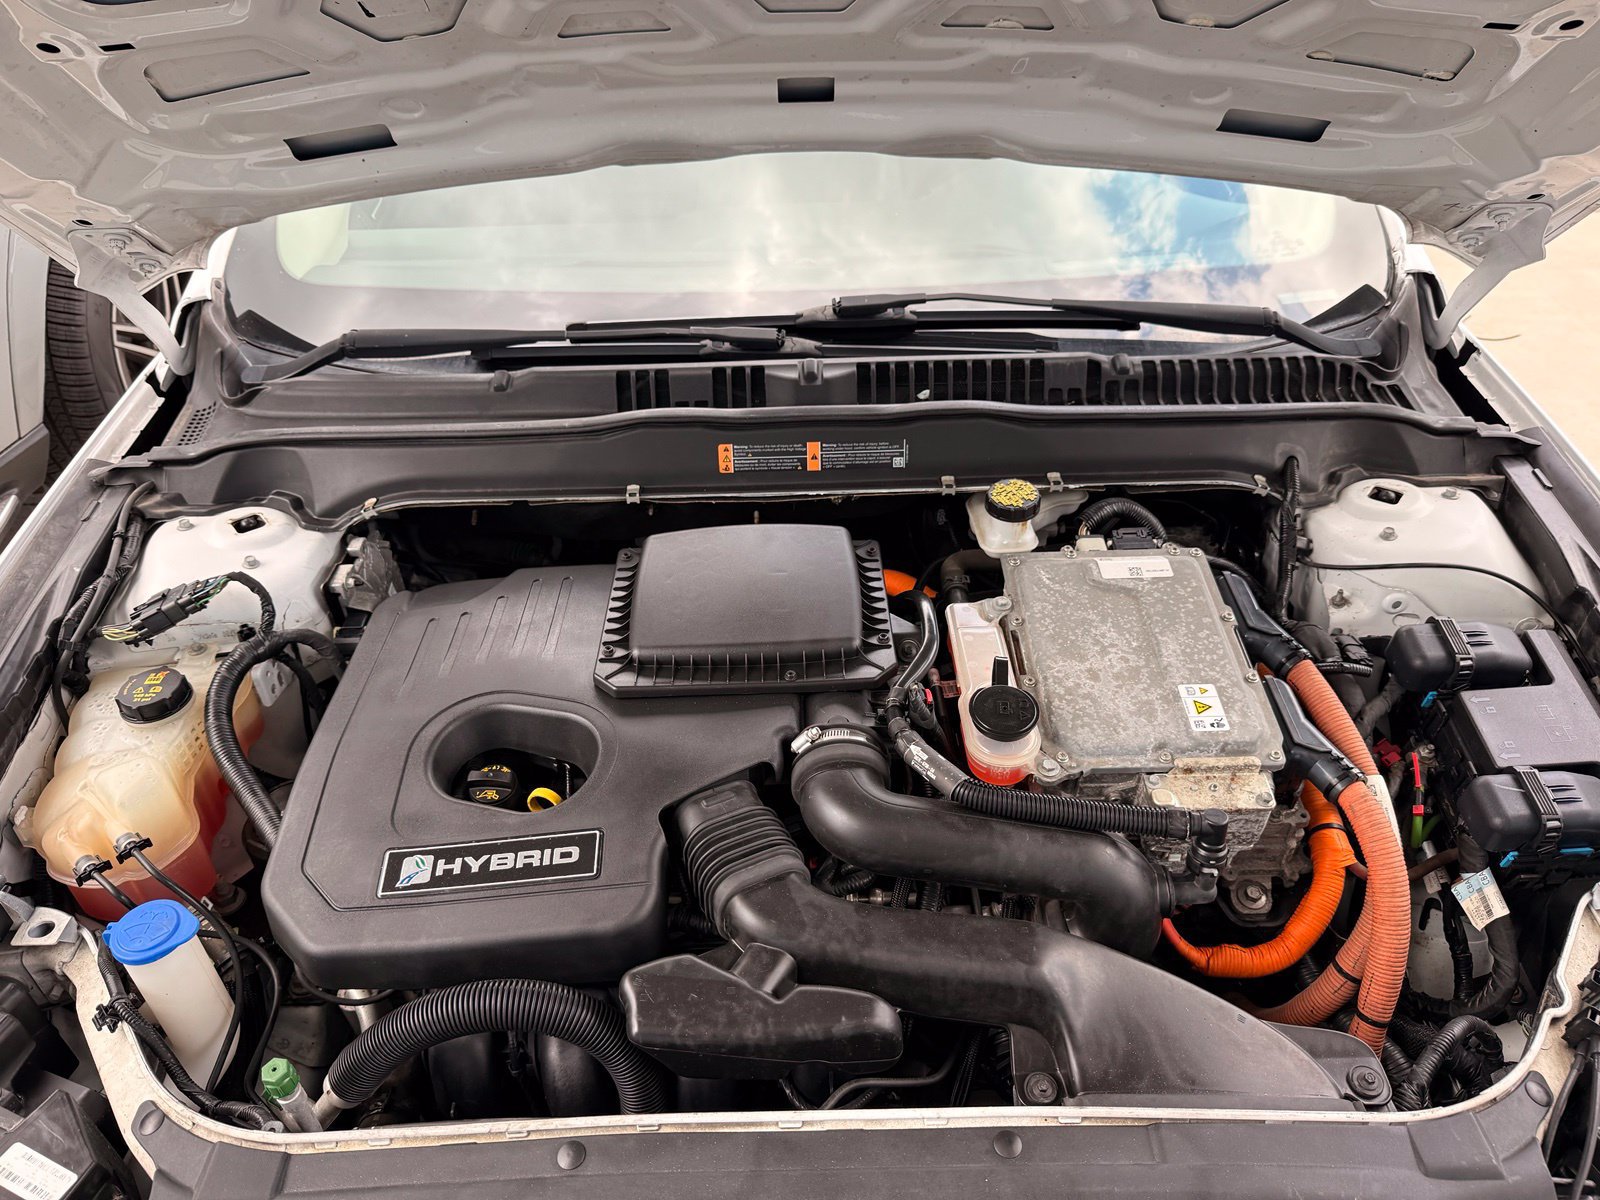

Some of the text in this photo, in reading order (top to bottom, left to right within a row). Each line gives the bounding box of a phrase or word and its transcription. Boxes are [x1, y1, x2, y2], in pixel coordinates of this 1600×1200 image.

[435, 846, 580, 877] HYBRID
[1479, 871, 1490, 886] CBA
[1465, 879, 1475, 894] CBA
